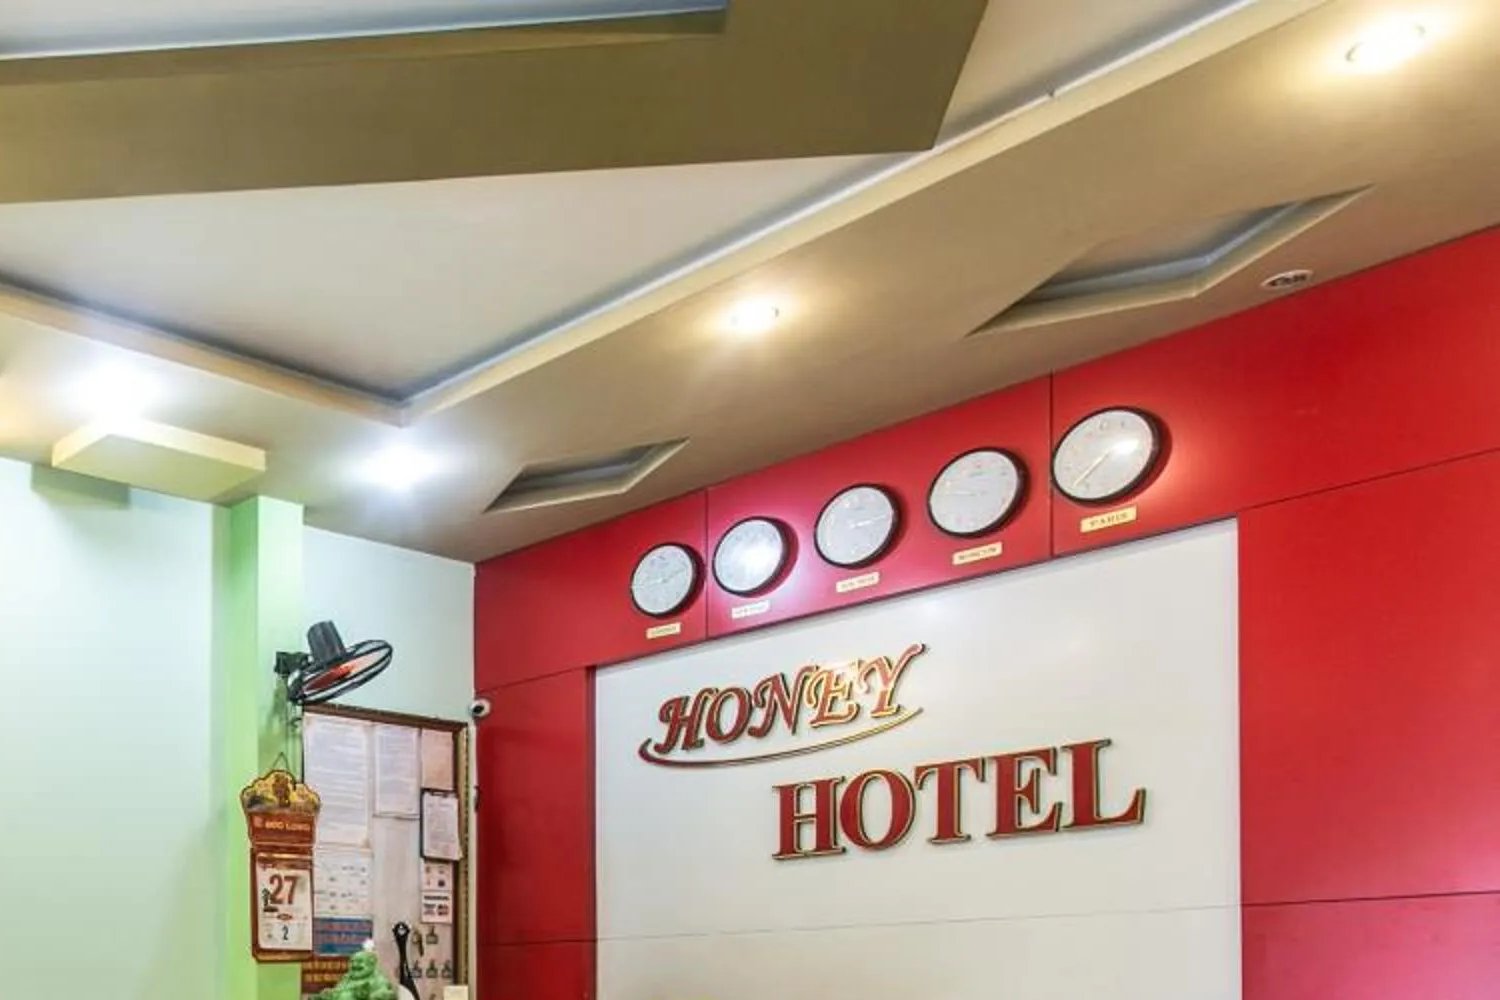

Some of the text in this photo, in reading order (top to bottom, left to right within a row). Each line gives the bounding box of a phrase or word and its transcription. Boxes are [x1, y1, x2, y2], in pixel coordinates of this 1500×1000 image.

[653, 643, 927, 755] HONEY
[771, 738, 1147, 861] HOTEL
[269, 874, 300, 905] 27
